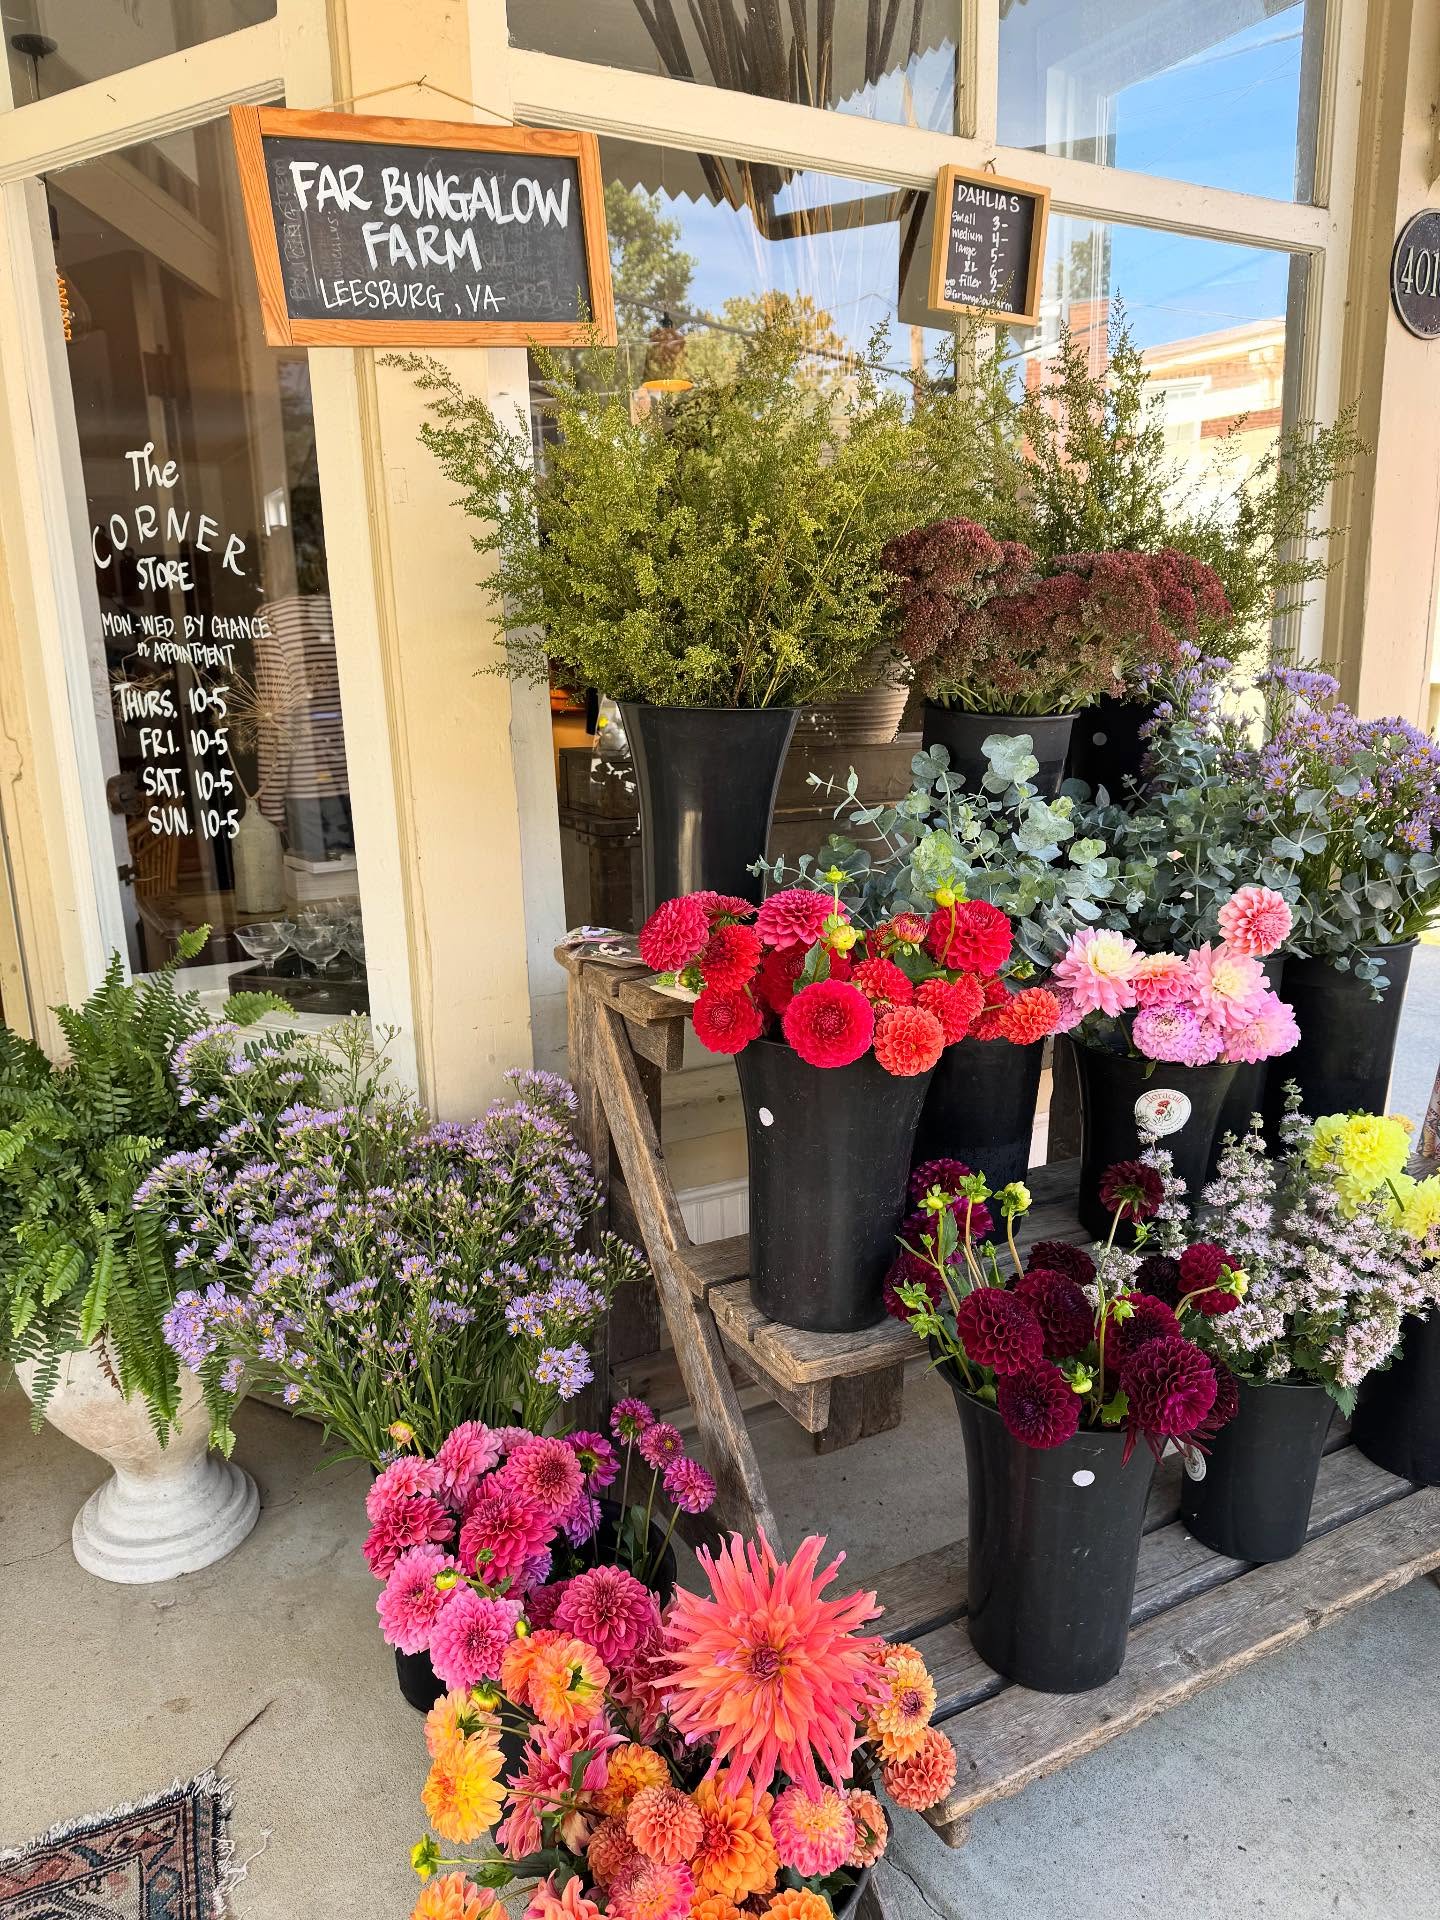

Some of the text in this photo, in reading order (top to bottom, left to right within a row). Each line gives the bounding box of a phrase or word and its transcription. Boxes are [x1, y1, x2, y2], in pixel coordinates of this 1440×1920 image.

[289, 161, 571, 229] FAR BUNGALOW
[958, 185, 1020, 213] DAHLIAS
[362, 221, 483, 273] FARM
[952, 228, 983, 243] medium
[955, 241, 977, 260] large
[959, 274, 981, 288] filler
[964, 260, 978, 273] XL
[1400, 246, 1440, 297] 401
[466, 284, 506, 314] VA
[124, 441, 180, 491] The
[92, 504, 246, 576] CORNER
[136, 556, 195, 592] STORE
[183, 615, 204, 639] BY
[211, 615, 273, 640] CHANCE
[154, 642, 235, 674] APPOINTMENT
[114, 682, 230, 722] THURS. 10-5
[139, 727, 229, 759] FRI. 10-5
[142, 766, 234, 801] SAT. 10-5
[147, 805, 240, 840] SUN. 10-5
